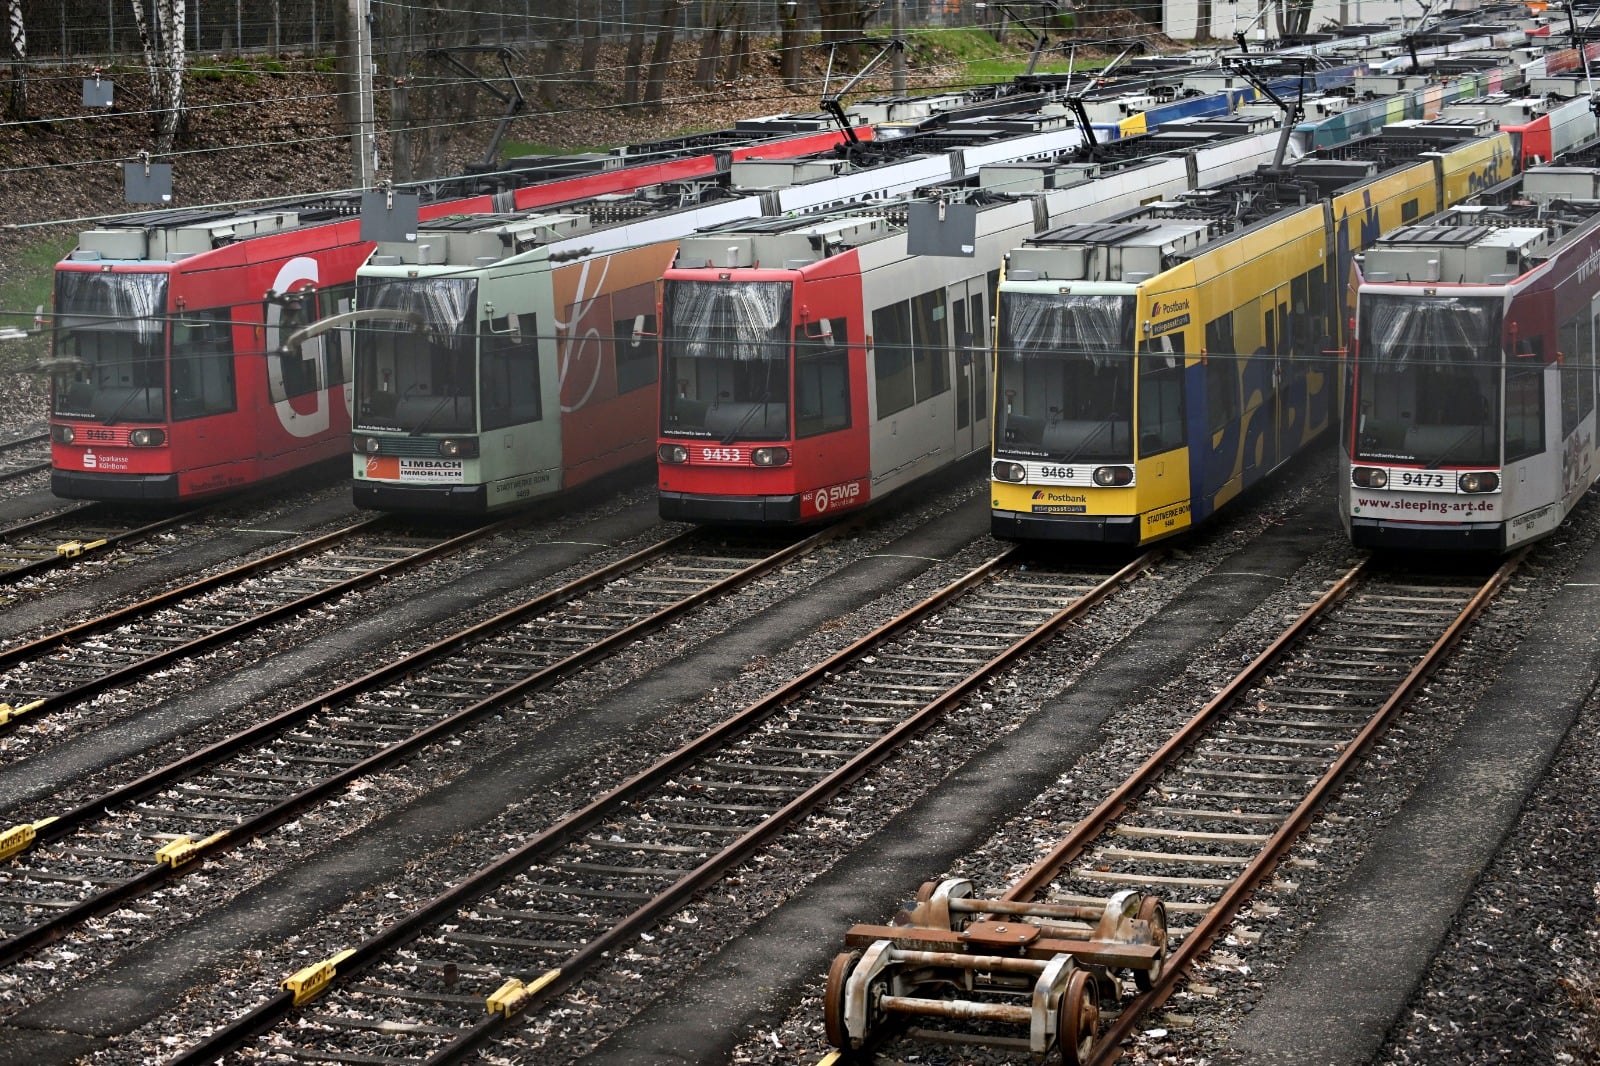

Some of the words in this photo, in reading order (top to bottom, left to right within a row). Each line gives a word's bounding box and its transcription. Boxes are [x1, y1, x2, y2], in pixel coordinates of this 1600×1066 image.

[1163, 298, 1190, 314] Postbank
[87, 429, 115, 440] 9463
[98, 454, 129, 463] Sparkasse
[703, 448, 741, 462] 9453
[98, 462, 128, 470] KölnBonn
[400, 460, 462, 469] LIMBACH
[1041, 466, 1074, 479] 9468
[1402, 473, 1444, 488] 9473
[830, 482, 860, 501] SWB
[1048, 493, 1087, 503] Postbank
[1358, 498, 1494, 514] www.sleeping-art.de
[1147, 508, 1178, 525] STADTWERKE
